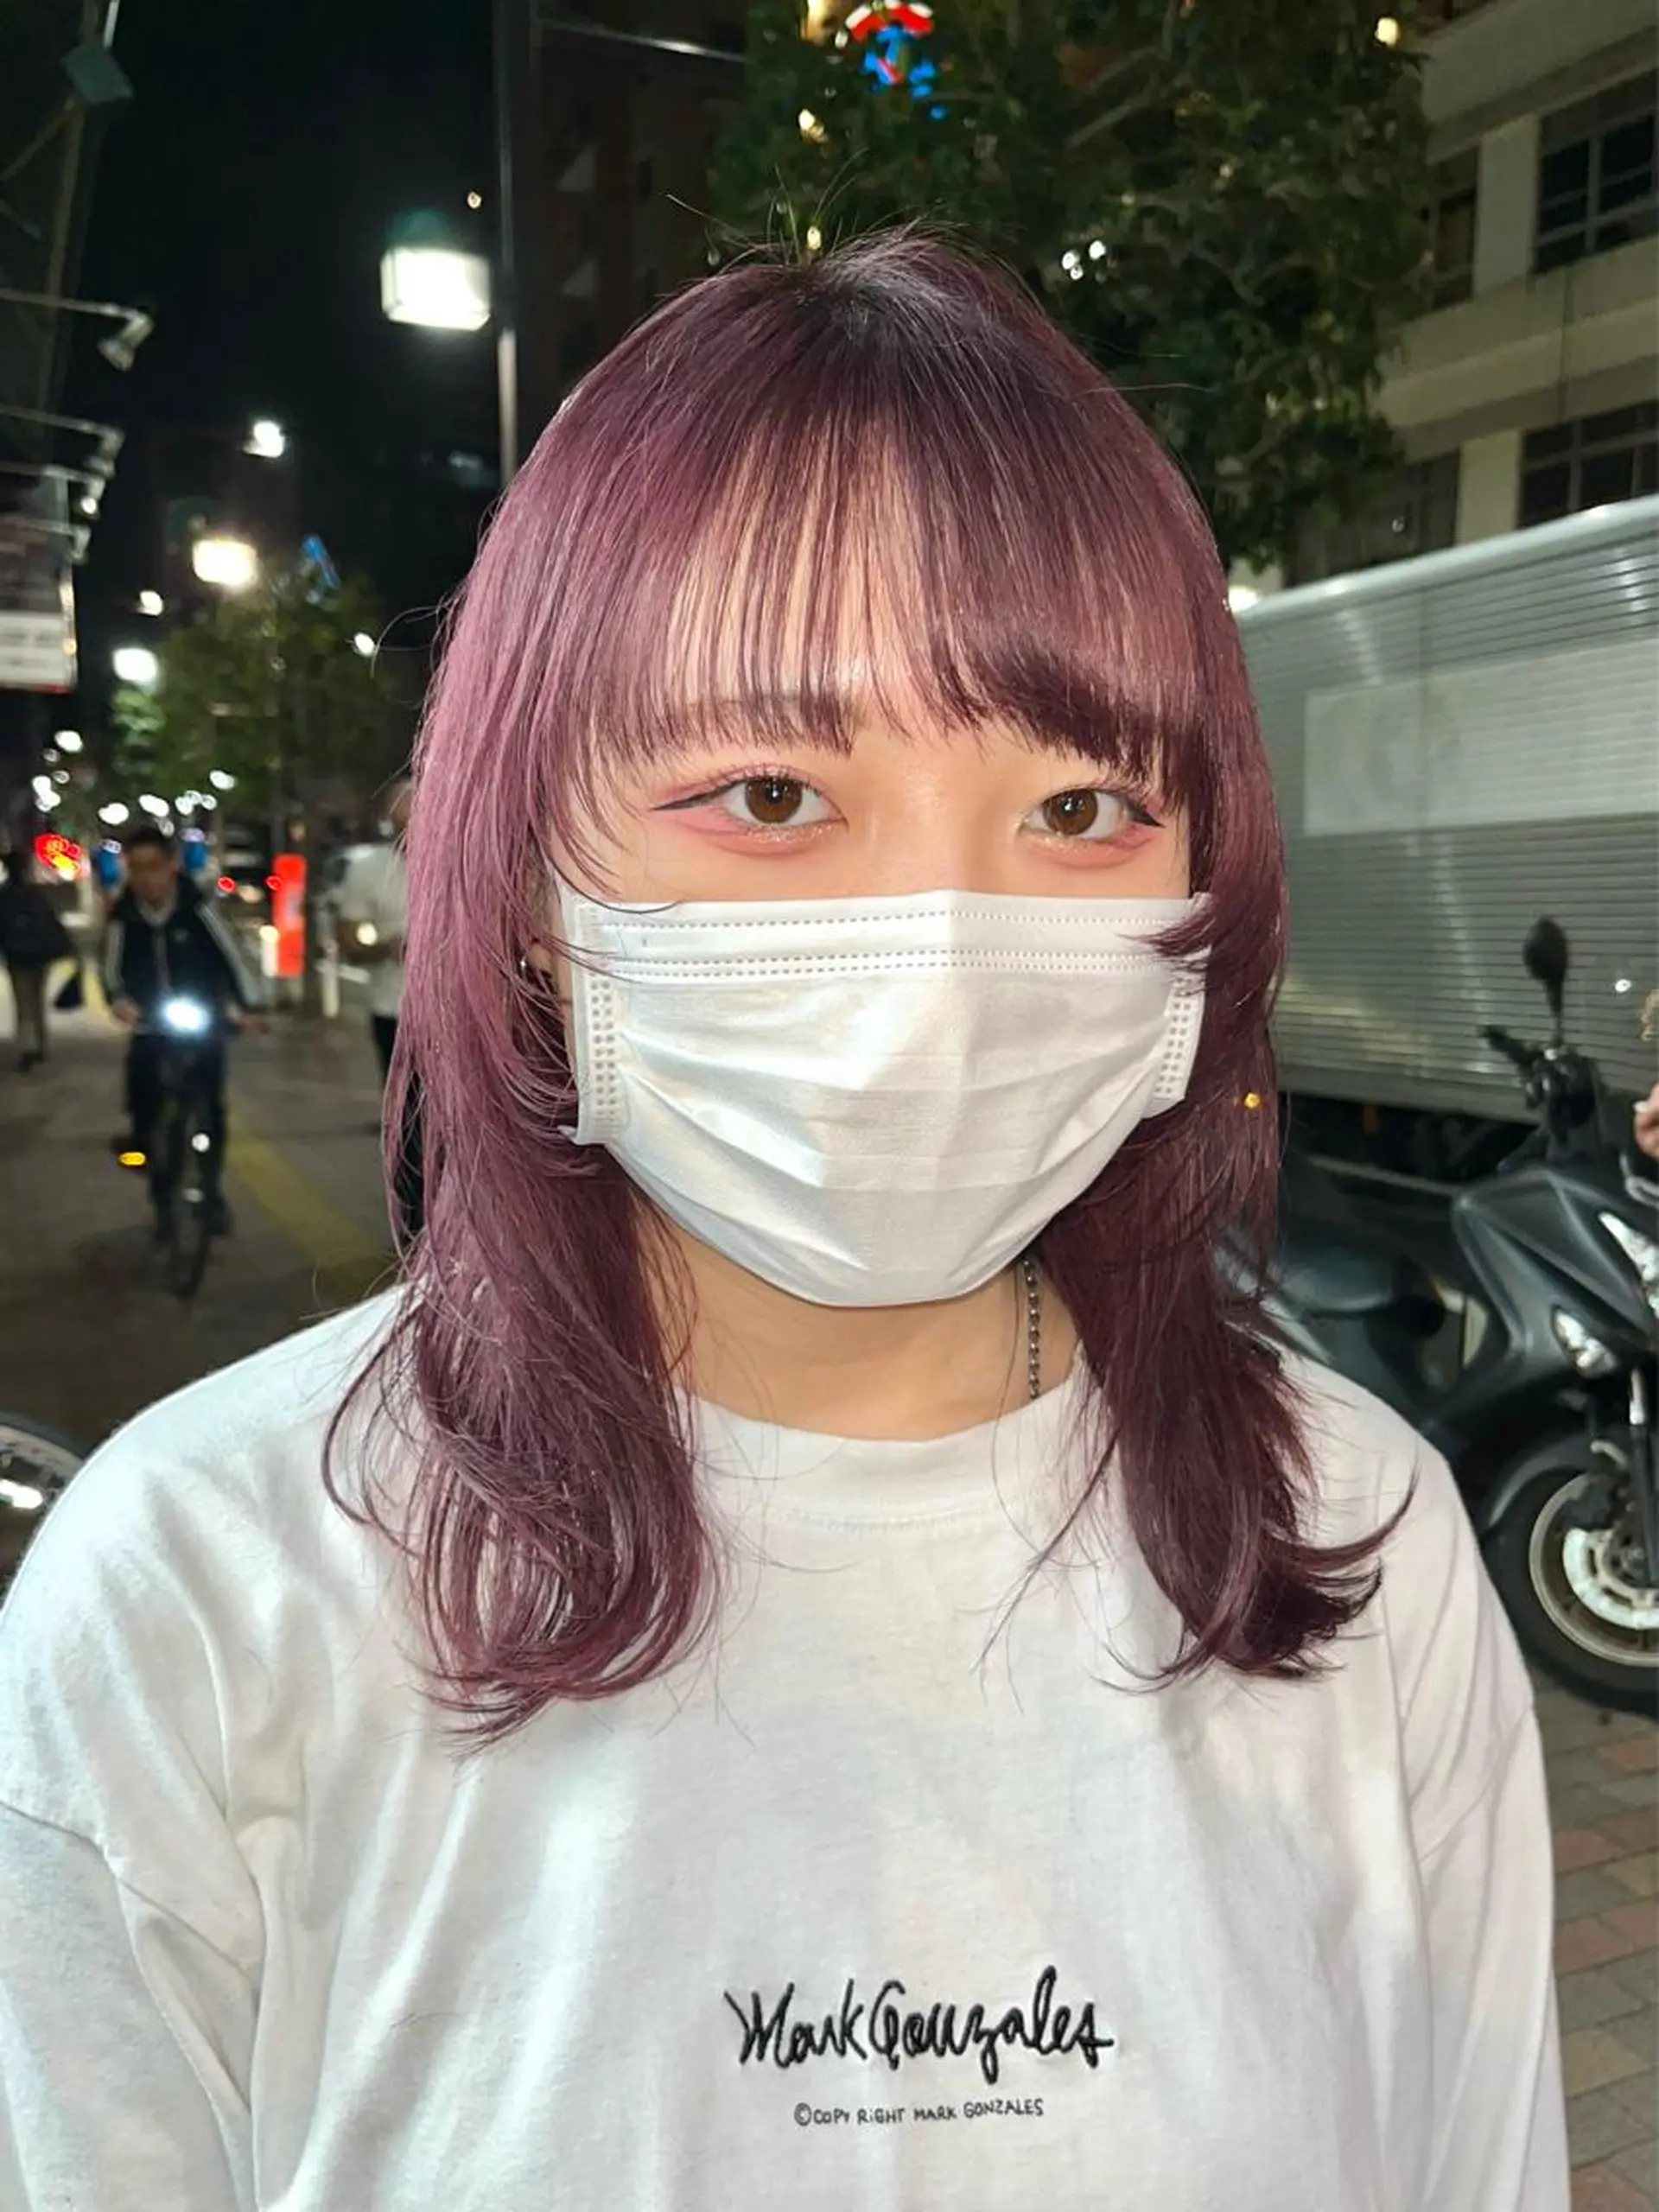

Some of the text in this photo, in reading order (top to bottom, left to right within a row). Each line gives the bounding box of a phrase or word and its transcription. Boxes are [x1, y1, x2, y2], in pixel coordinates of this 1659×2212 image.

[724, 1965, 1115, 2086] Mark Gonzales
[912, 2104, 958, 2122] MARK
[963, 2097, 1045, 2120] GONZALES
